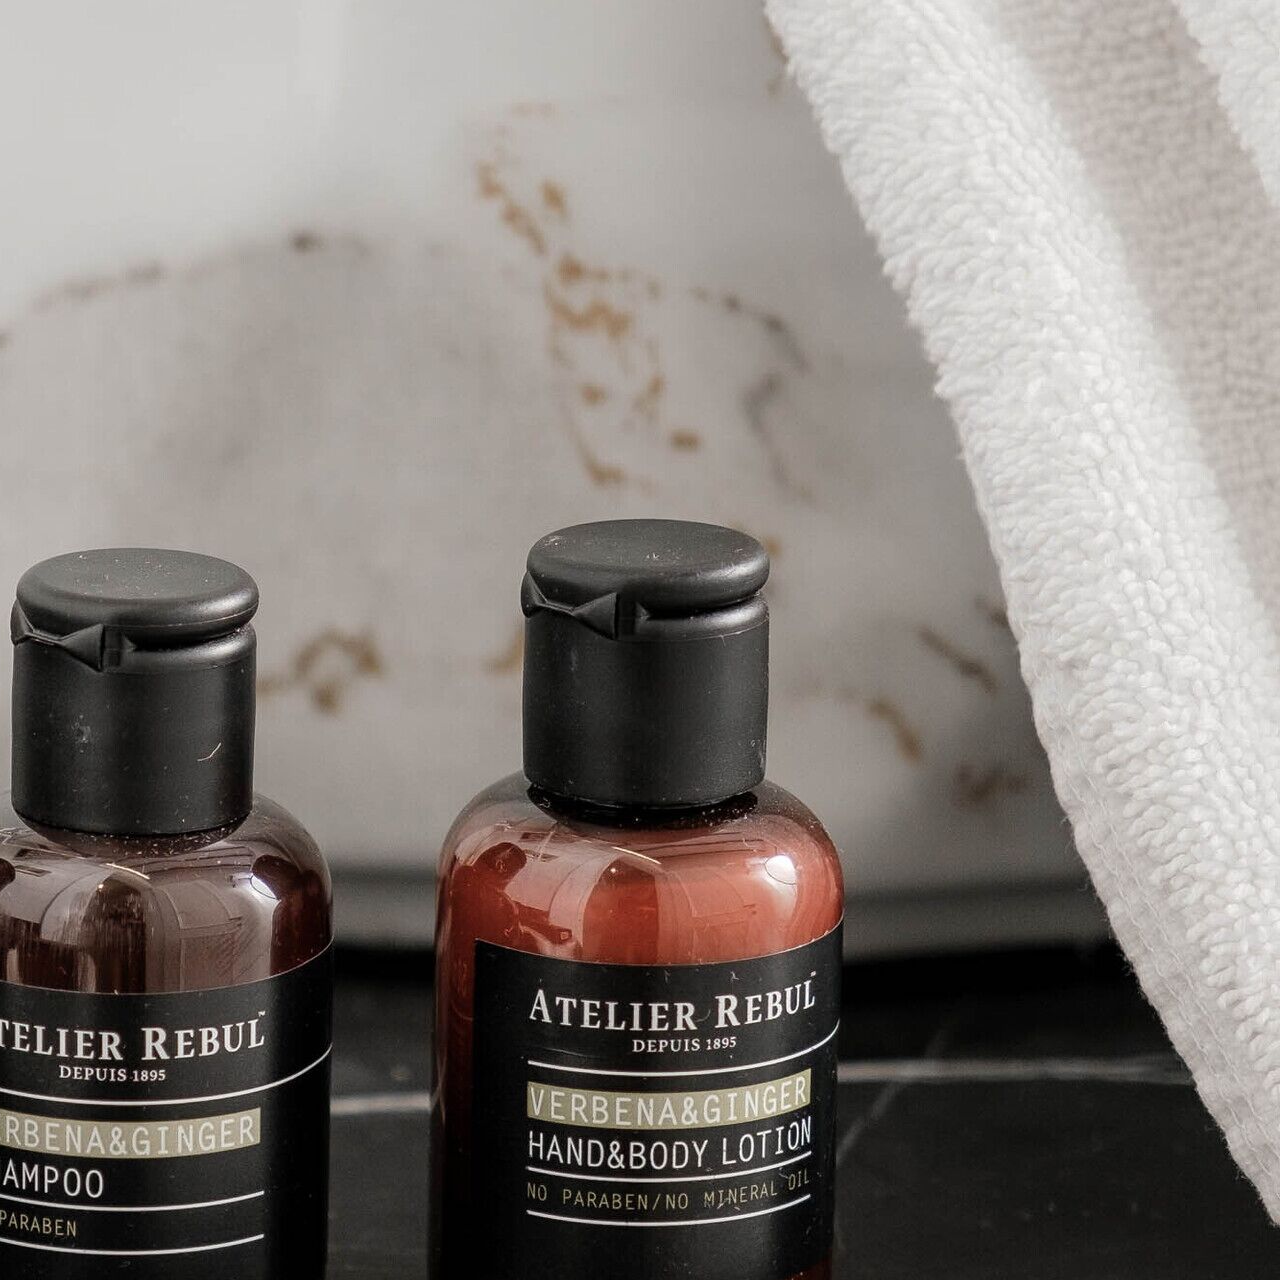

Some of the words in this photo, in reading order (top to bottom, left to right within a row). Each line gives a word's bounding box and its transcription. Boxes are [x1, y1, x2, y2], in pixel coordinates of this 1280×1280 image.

[529, 989, 698, 1031] ATELIER
[632, 1038, 700, 1053] DEPUIS
[706, 1036, 737, 1051] 1895
[59, 1064, 127, 1082] DEPUIS
[132, 1069, 166, 1082] 1895
[529, 1076, 807, 1127] VERBENA&GINGER
[529, 1131, 709, 1170] HAND&BODY
[722, 1116, 812, 1166] LOTION
[527, 1183, 547, 1201] NO
[563, 1188, 688, 1211] PARABEN/NO
[704, 1182, 777, 1208] MINERAL
[787, 1168, 810, 1190] OIL
[0, 1209, 77, 1237] PARABEN
